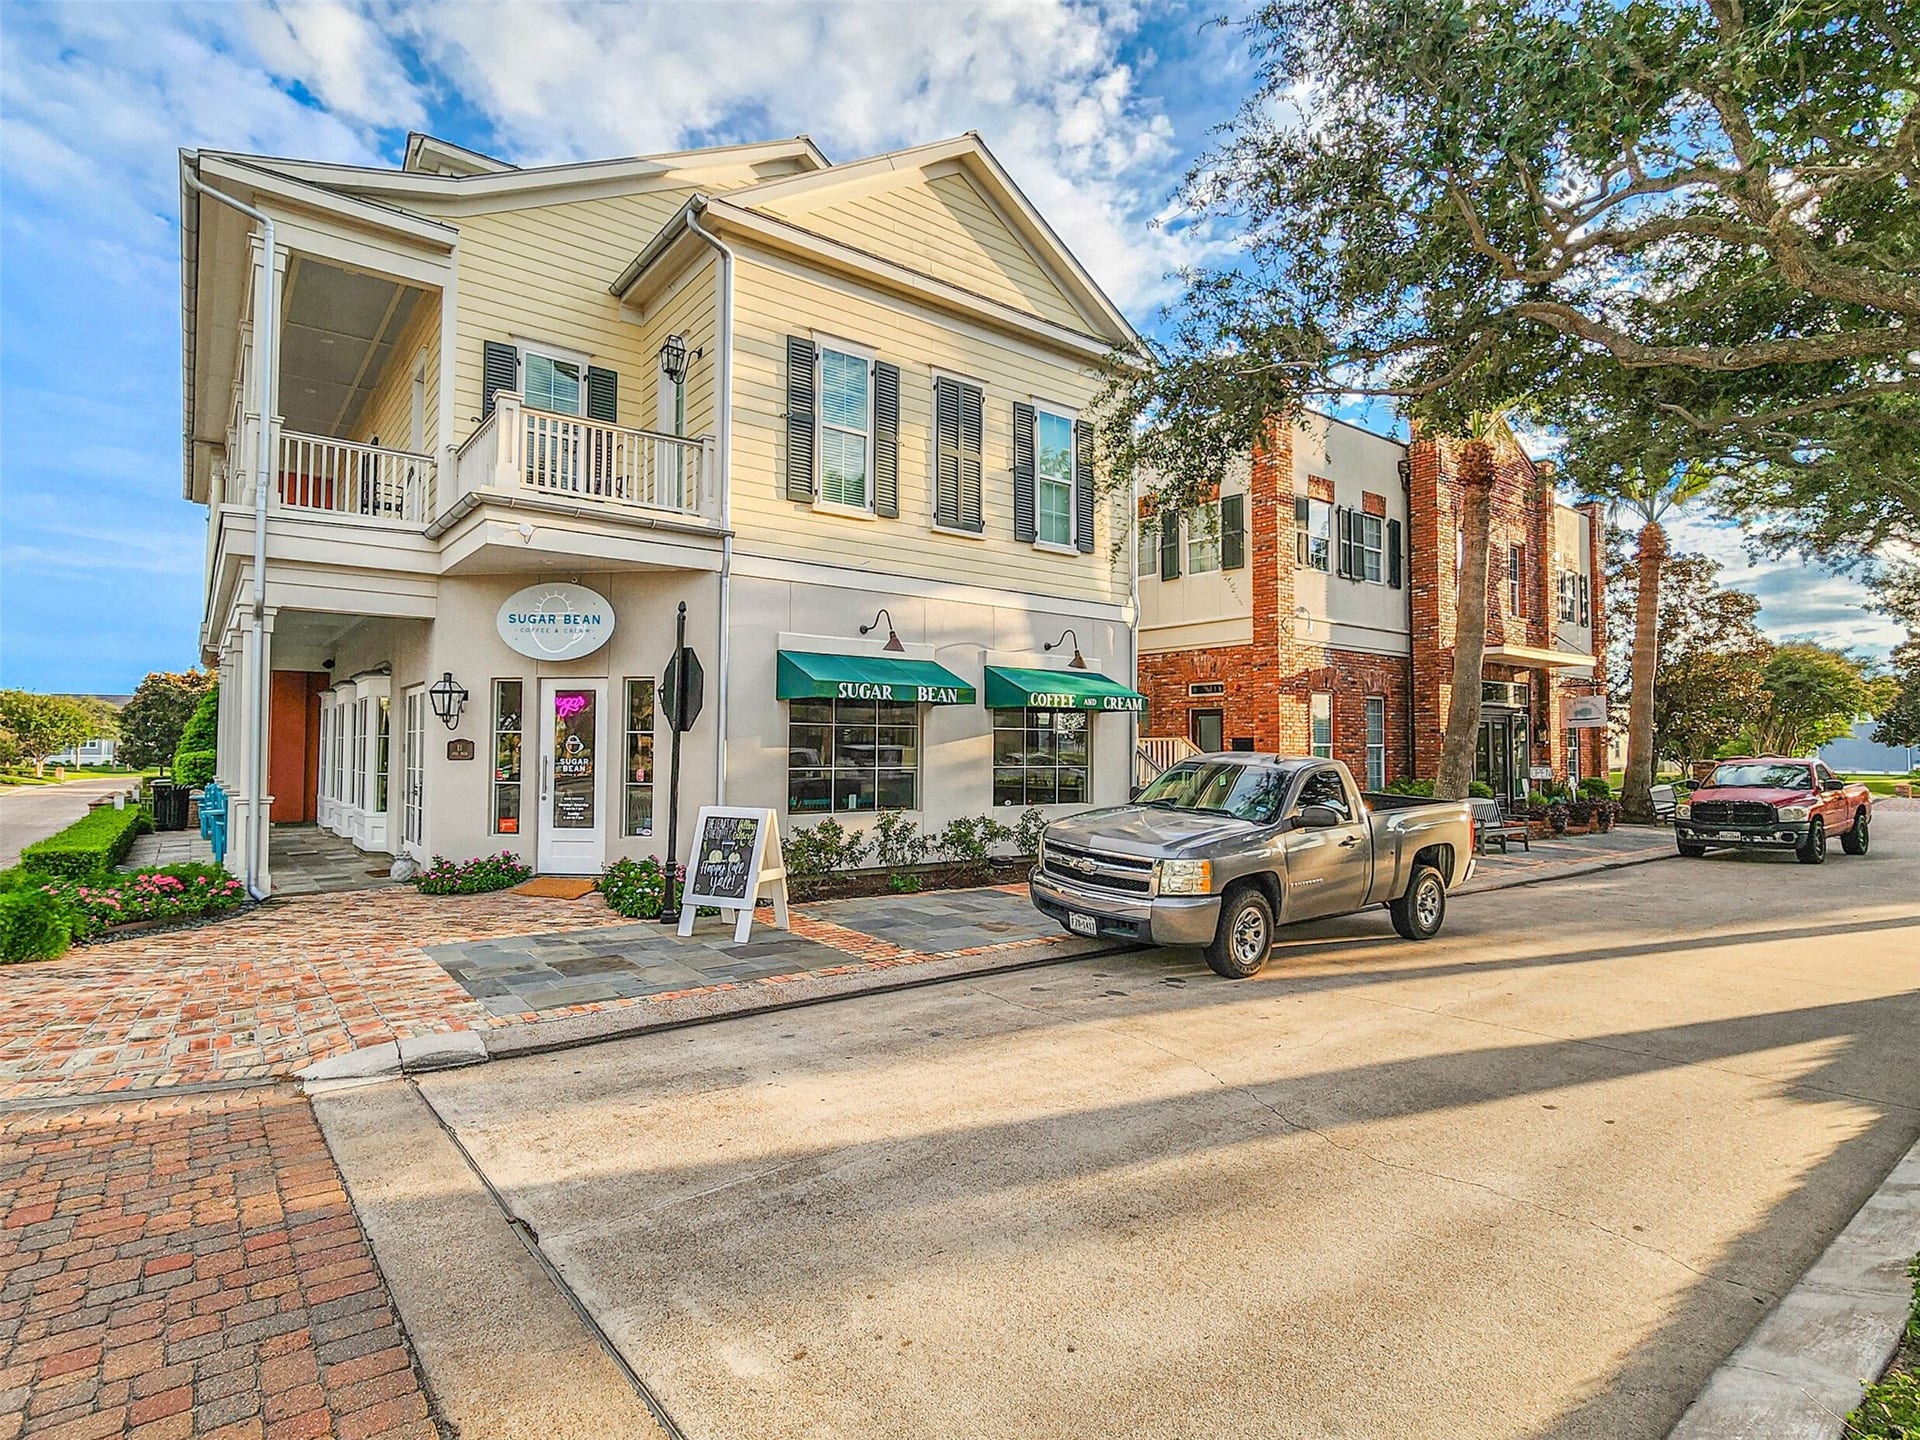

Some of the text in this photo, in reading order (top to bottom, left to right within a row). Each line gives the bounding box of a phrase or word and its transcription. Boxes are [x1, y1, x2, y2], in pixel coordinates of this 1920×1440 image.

[508, 613, 601, 625] SUGAR BEAN
[838, 682, 958, 704] SUGAR BEAN
[1030, 692, 1142, 711] COFFEE AND CREAM
[559, 757, 589, 765] SUGAR
[700, 860, 727, 876] Happy
